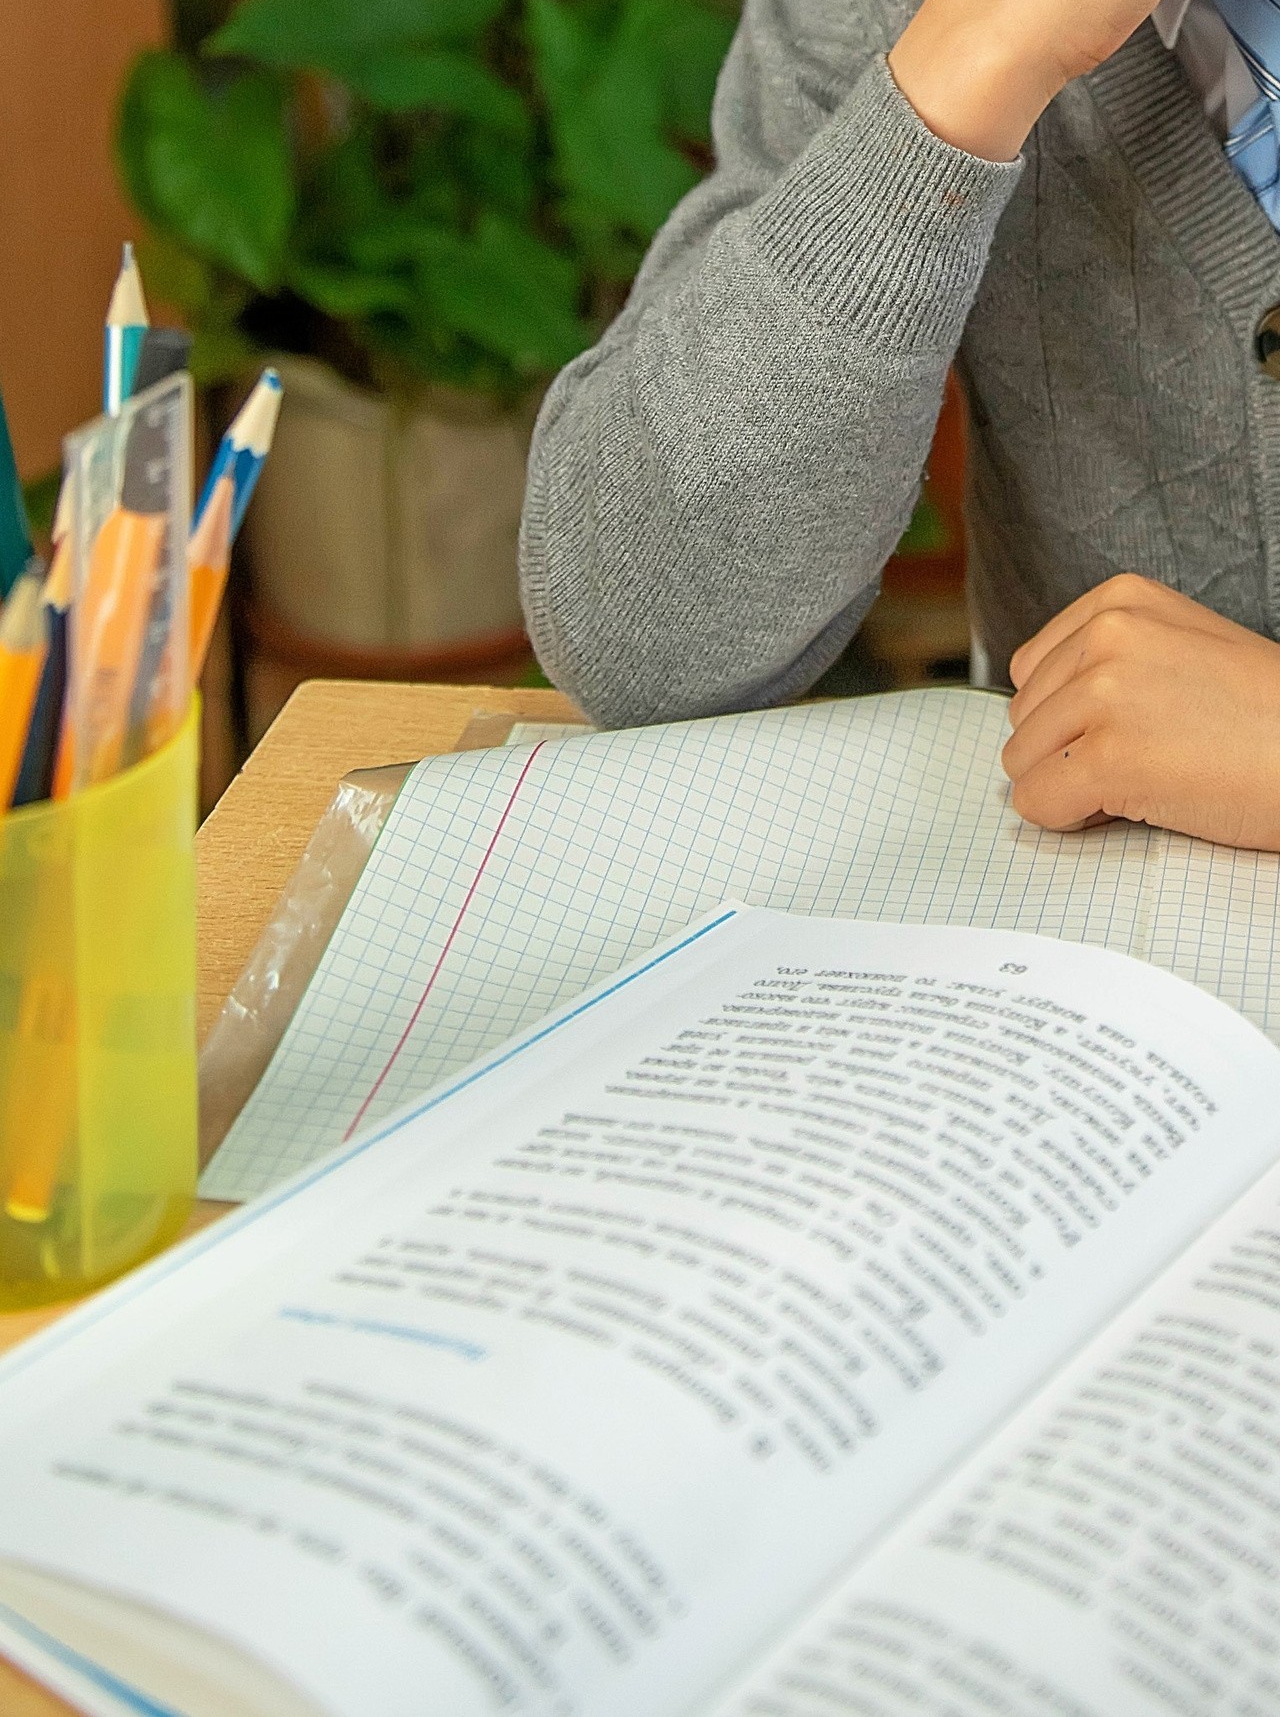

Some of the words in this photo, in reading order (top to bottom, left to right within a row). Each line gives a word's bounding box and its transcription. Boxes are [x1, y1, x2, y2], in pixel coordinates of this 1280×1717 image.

[776, 966, 809, 976] его,
[998, 962, 1028, 975] 63
[814, 970, 908, 983] понюхает
[914, 977, 939, 987] то
[753, 979, 813, 992] Долго
[818, 983, 904, 998] труслива.
[947, 982, 1007, 999] улья:
[737, 992, 799, 1003] выско-
[800, 995, 832, 1006] что
[908, 991, 961, 1008] была
[836, 998, 893, 1012] вдруг
[1012, 995, 1088, 1024] вокруг
[723, 1004, 842, 1021] недоверчиво.
[964, 1001, 1049, 1032] Копуша
[676, 1030, 730, 1042] улей
[1053, 1026, 1069, 1036] а
[1097, 1024, 1137, 1049] она
[1077, 1034, 1157, 1086] укусит,
[1146, 1051, 1218, 1116] ходила
